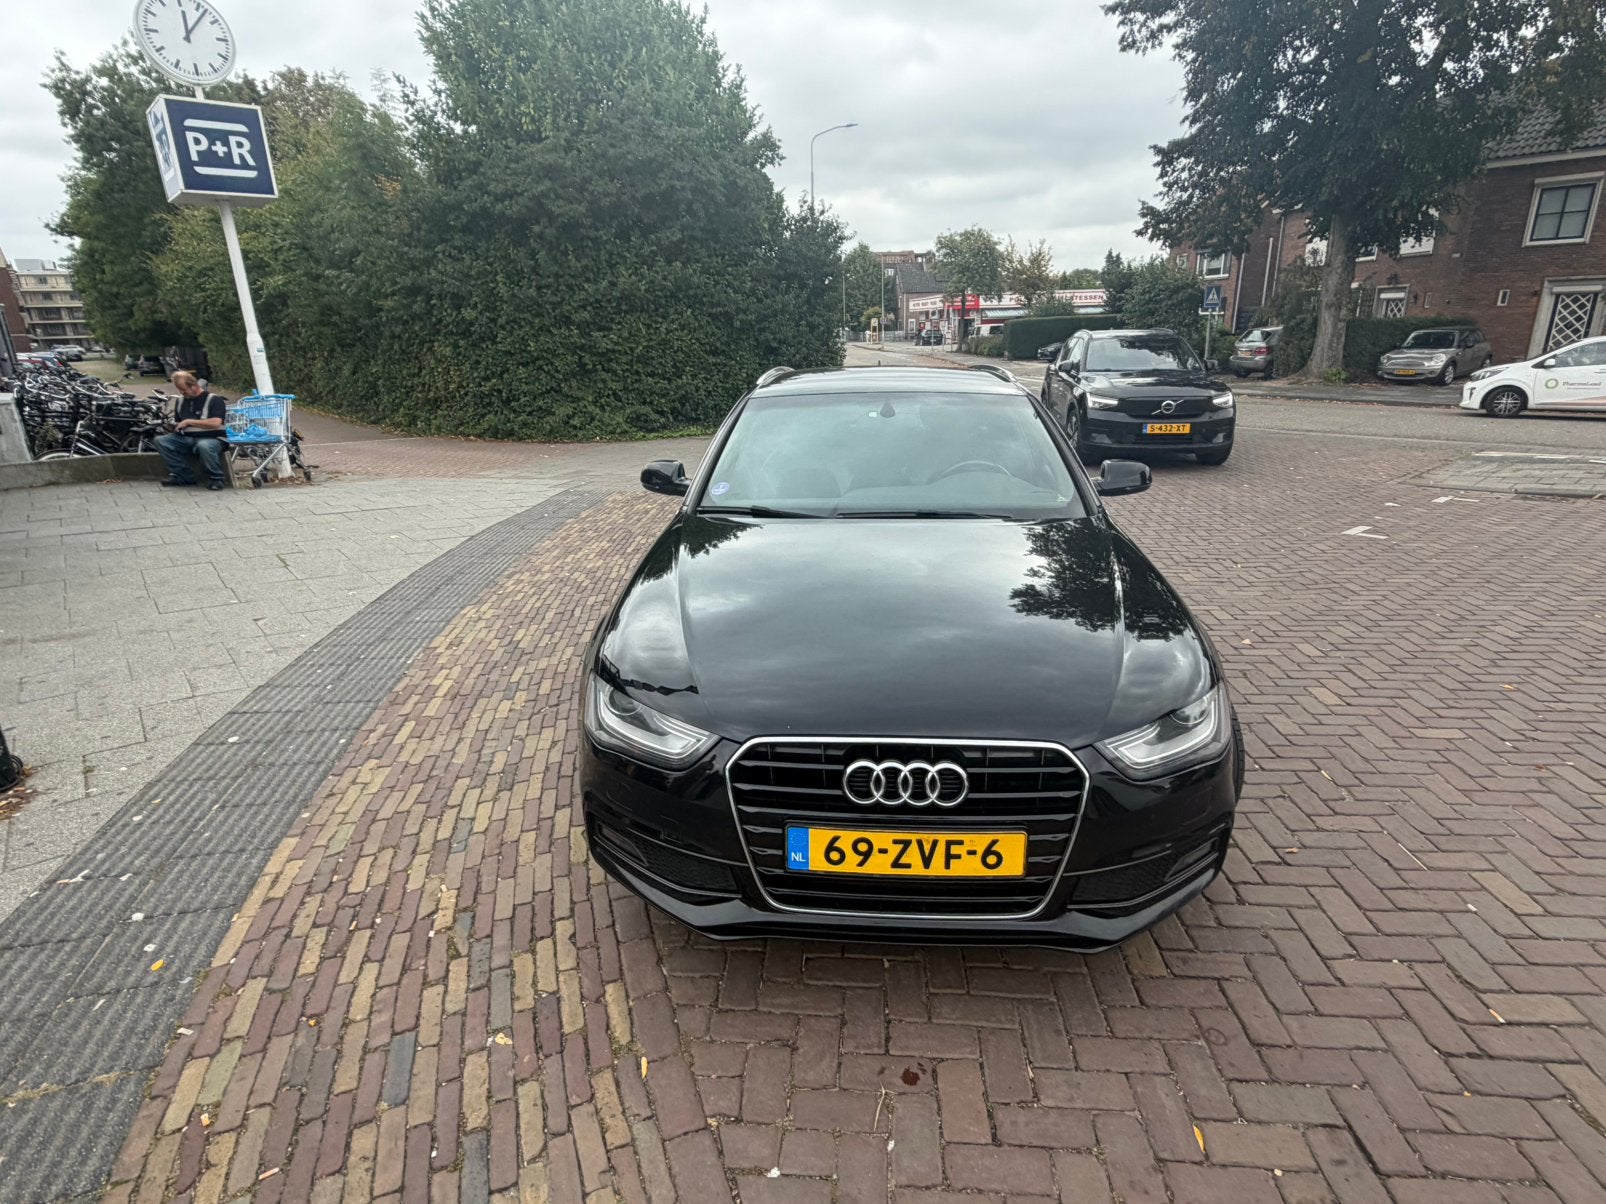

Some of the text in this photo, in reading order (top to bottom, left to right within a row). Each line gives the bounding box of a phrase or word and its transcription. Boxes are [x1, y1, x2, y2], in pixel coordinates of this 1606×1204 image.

[185, 130, 257, 166] P+R
[1150, 424, 1186, 433] S-432-XT
[791, 834, 1004, 871] NL 69-ZVF-6
